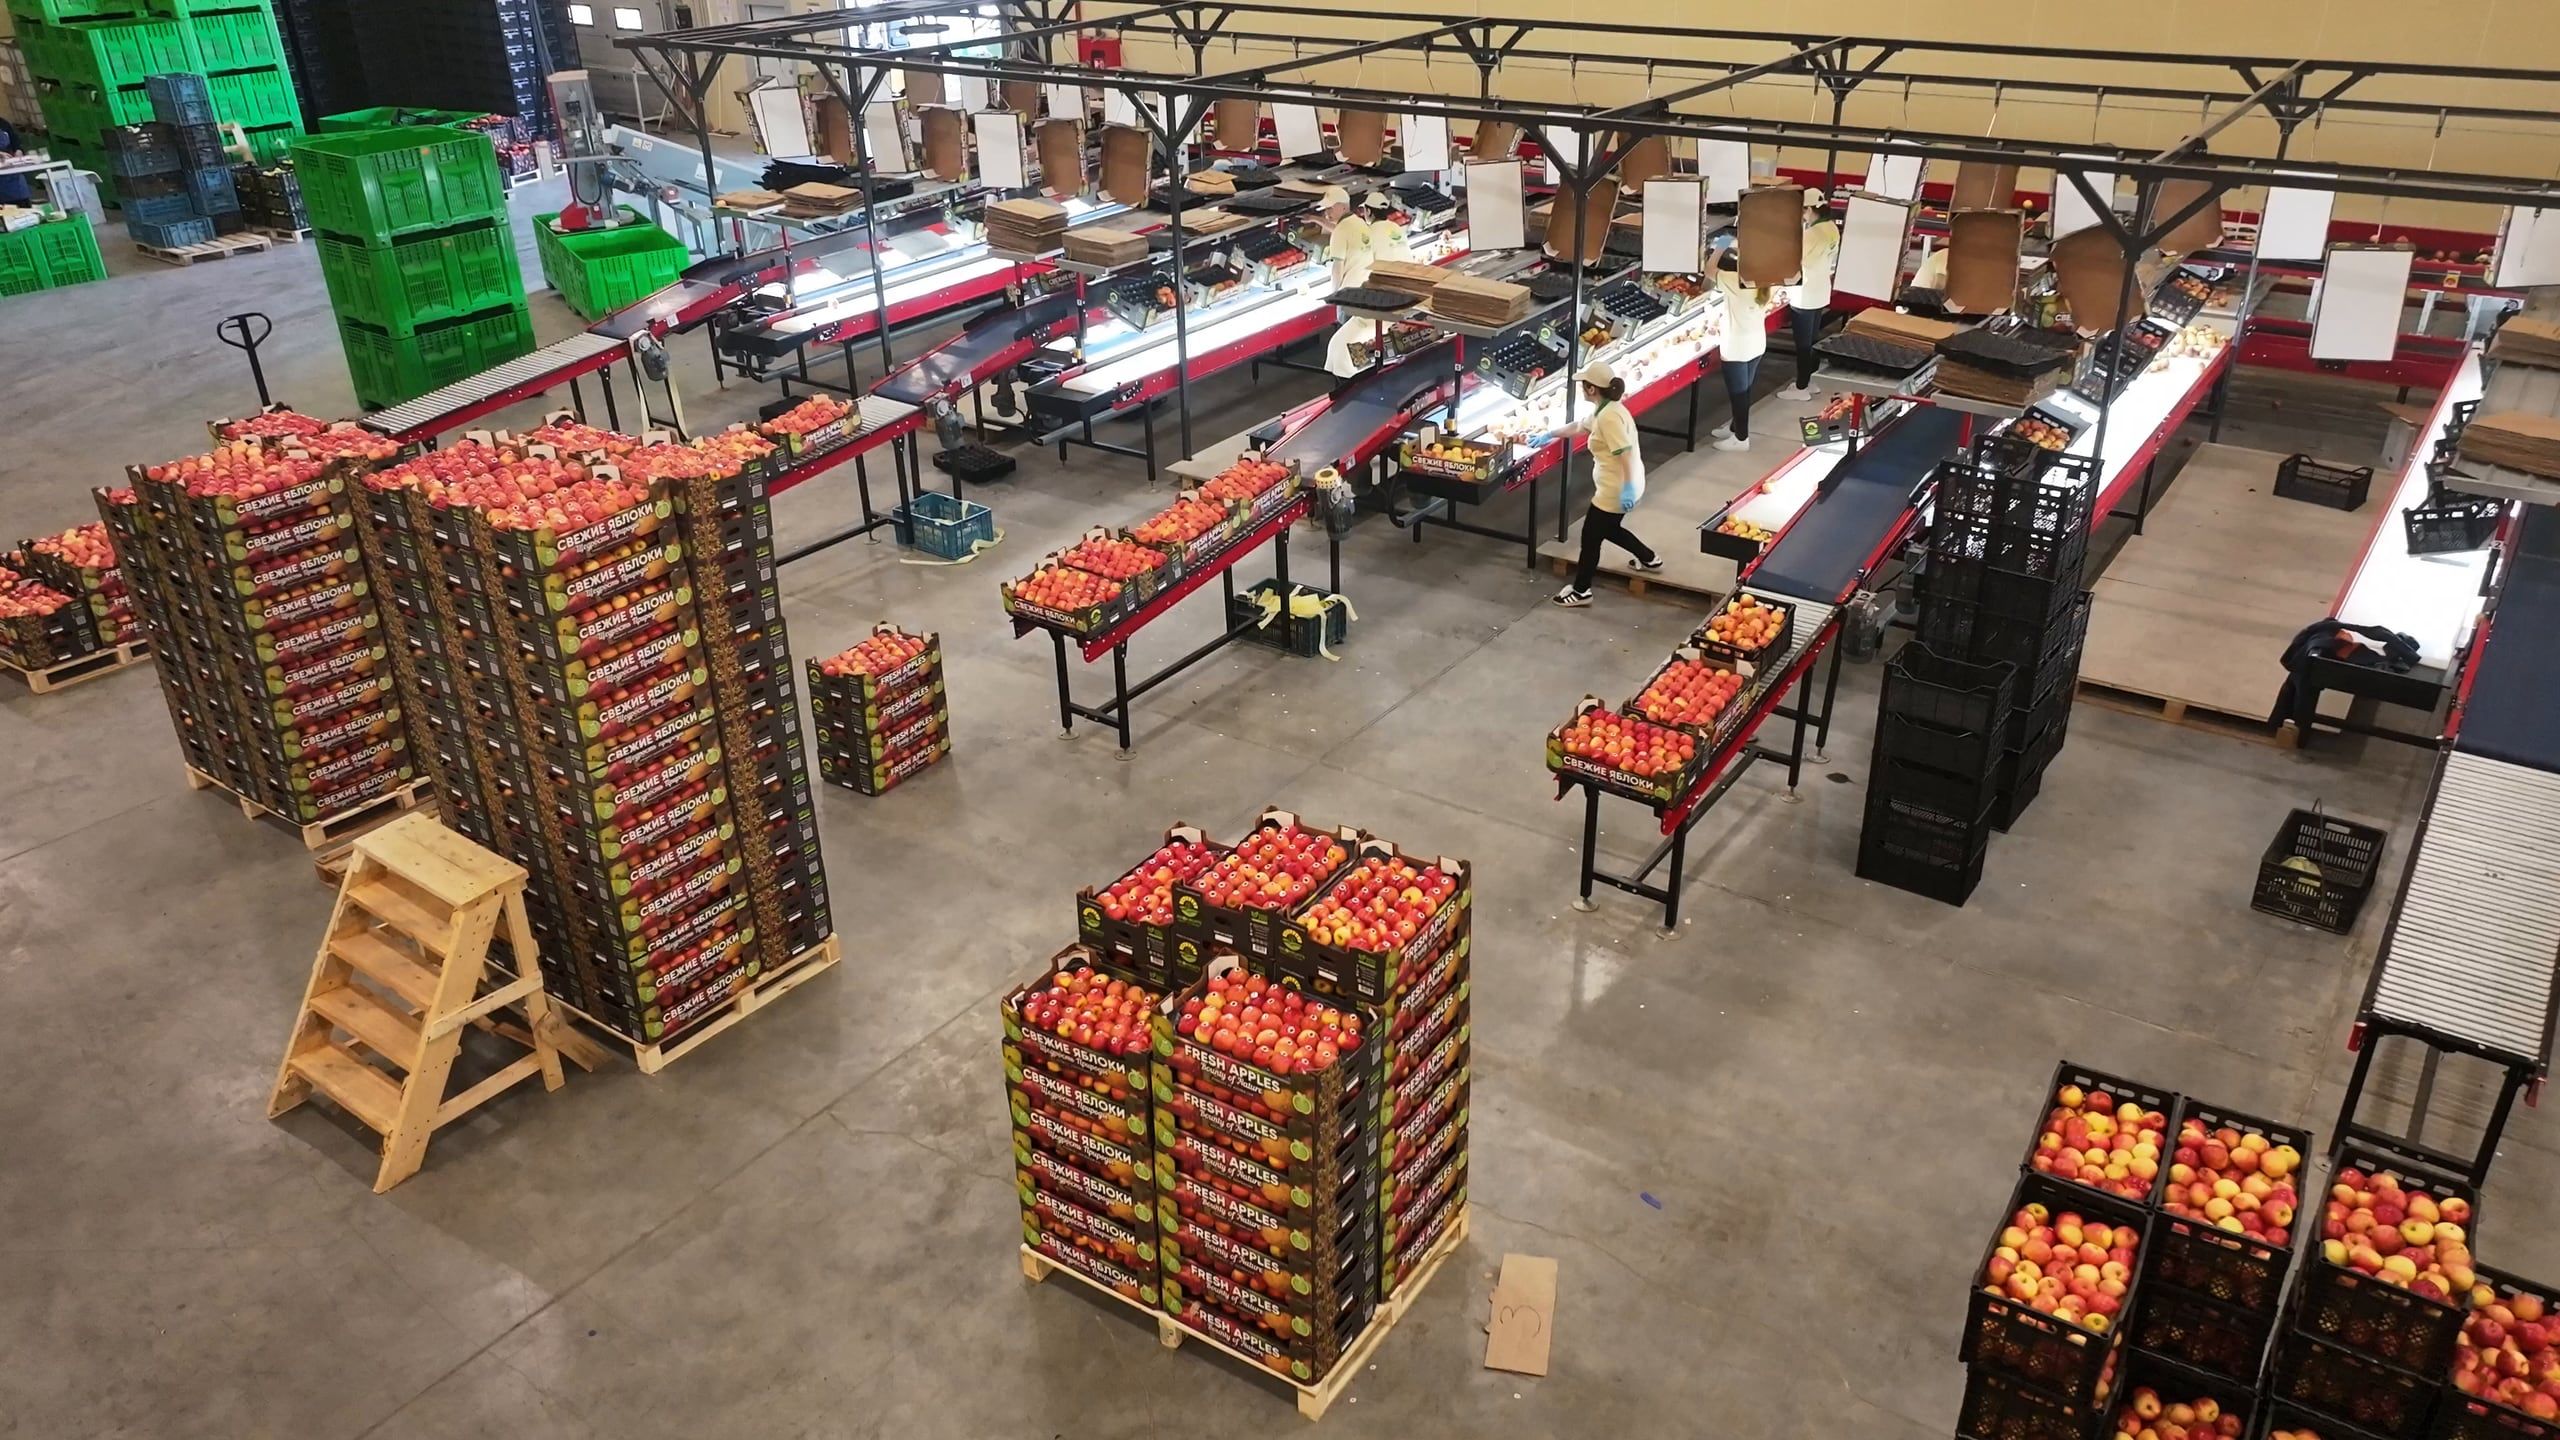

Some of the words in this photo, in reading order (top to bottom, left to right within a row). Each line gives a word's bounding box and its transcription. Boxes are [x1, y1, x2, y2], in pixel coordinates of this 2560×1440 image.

[1412, 456, 1443, 466] СВЕЖИЕ
[1444, 460, 1475, 472] ЯБЛОКИ
[236, 494, 282, 514] СВЕЖИЕ
[284, 480, 326, 499] ЯБЛОКИ
[246, 530, 291, 549] СВЕЖИЕ
[293, 516, 335, 535] ЯБЛОКИ
[557, 524, 606, 551] СВЕЖИЕ
[608, 503, 653, 530] ЯБЛОКИ
[105, 568, 122, 578] FRE
[254, 564, 298, 584] СВЕЖИЕ
[300, 550, 342, 569] ЯБЛОКИ
[567, 568, 616, 595] СВЕЖИЕ
[617, 547, 662, 574] ЯБЛОКИ
[114, 595, 131, 606] FRE
[264, 598, 307, 618] СВЕЖИЕ
[309, 584, 351, 603] ЯБЛОКИ
[580, 611, 627, 638] СВЕЖИЕ
[629, 591, 674, 617] ЯБЛОКИ
[1015, 601, 1043, 615] СВЕЖИЕ
[1045, 610, 1075, 624] ЯБЛОКИ
[122, 622, 138, 631] FRE
[275, 631, 319, 650] СВЕЖИЕ
[321, 617, 361, 636] ЯБЛОКИ
[285, 663, 327, 683] СВЕЖИЕ
[329, 648, 370, 667] ЯБЛОКИ
[588, 655, 635, 682] СВЕЖИЕ
[637, 632, 681, 659] ЯБЛОКИ
[881, 669, 901, 684] FRESH
[903, 655, 926, 673] APPLES
[292, 696, 335, 715] СВЕЖИЕ
[337, 680, 377, 699] ЯБЛОКИ
[600, 695, 645, 722] СВЕЖИЕ
[647, 672, 690, 699] ЯБЛОКИ
[883, 700, 903, 716] FRESH
[905, 686, 928, 704] APPLES
[301, 727, 343, 747] СВЕЖИЕ
[345, 712, 384, 731] ЯБЛОКИ
[655, 712, 697, 740] ЯБЛОКИ
[888, 729, 908, 745] FRESH
[910, 715, 932, 733] APPLES
[309, 760, 350, 780] СВЕЖИЕ
[351, 741, 390, 763] ЯБЛОКИ
[615, 775, 659, 804] СВЕЖИЕ
[661, 752, 704, 780] ЯБЛОКИ
[891, 759, 911, 775] FRESH
[913, 744, 935, 762] APPLES
[1564, 756, 1607, 776] СВЕЖИЕ
[1610, 770, 1653, 790] ЯБЛОКИ
[317, 786, 357, 808] СВЕЖИЕ
[360, 769, 397, 790] ЯБЛОКИ
[621, 815, 665, 844] СВЕЖИЕ
[667, 792, 709, 820] ЯБЛОКИ
[630, 852, 674, 881] СВЕЖИЕ
[676, 828, 718, 856] ЯБЛОКИ
[640, 888, 683, 916] СВЕЖИЕ
[685, 863, 726, 892] ЯБЛОКИ
[1405, 931, 1428, 962] FRESH
[1430, 901, 1455, 936] APPLES
[656, 958, 698, 987] СВЕЖИЕ
[700, 933, 739, 962] ЯБЛОКИ
[1401, 980, 1425, 1011] FRESH
[1427, 949, 1453, 985] APPLES
[663, 992, 705, 1022] СВЕЖИЕ
[706, 966, 745, 996] ЯБЛОКИ
[1401, 1024, 1424, 1056] FRESH
[1426, 993, 1453, 1029] APPLES
[1022, 1027, 1070, 1054] СВЕЖИЕ
[1073, 1048, 1125, 1074] ЯБЛОКИ
[1185, 1045, 1226, 1070] FRESH
[1230, 1064, 1280, 1092] APPLES
[1401, 1068, 1424, 1100] FRESH
[1426, 1037, 1453, 1072] APPLES
[1023, 1069, 1071, 1097] СВЕЖИЕ
[1074, 1091, 1125, 1119] ЯБЛОКИ
[1201, 1062, 1226, 1080] Bounty
[1228, 1075, 1235, 1084] of
[1237, 1077, 1262, 1094] Nature
[1184, 1092, 1224, 1118] FRESH
[1228, 1112, 1277, 1140] APPLES
[1200, 1110, 1224, 1127] Bounty
[1226, 1123, 1234, 1132] of
[1235, 1125, 1260, 1140] Nature
[1401, 1110, 1425, 1141] FRESH
[1427, 1079, 1453, 1114] APPLES
[1031, 1113, 1079, 1141] СВЕЖИЕ
[1082, 1136, 1131, 1165] ЯБЛОКИ
[1186, 1137, 1225, 1163] FRESH
[1230, 1157, 1279, 1186] APPLES
[1401, 1154, 1424, 1185] FRESH
[1426, 1122, 1452, 1156] APPLES
[1033, 1154, 1080, 1182] СВЕЖИЕ
[1083, 1177, 1132, 1206] ЯБЛОКИ
[1228, 1168, 1235, 1176] of
[1402, 1196, 1425, 1227] FRESH
[1427, 1164, 1452, 1198] APPLES
[1036, 1193, 1084, 1221] СВЕЖИЕ
[1087, 1216, 1135, 1246] ЯБЛОКИ
[1186, 1181, 1225, 1207] FRESH
[1229, 1201, 1278, 1229] APPLES
[1189, 1224, 1227, 1249] FRESH
[1232, 1244, 1279, 1273] APPLES
[1402, 1234, 1425, 1265] FRESH
[1427, 1200, 1452, 1234] APPLES
[1041, 1233, 1086, 1263] СВЕЖИЕ
[1090, 1259, 1137, 1288] ЯБЛОКИ
[1191, 1265, 1229, 1291] FRESH
[1233, 1287, 1279, 1315] APPLES
[1196, 1309, 1230, 1333] RESH
[1234, 1328, 1280, 1357] APPLES
